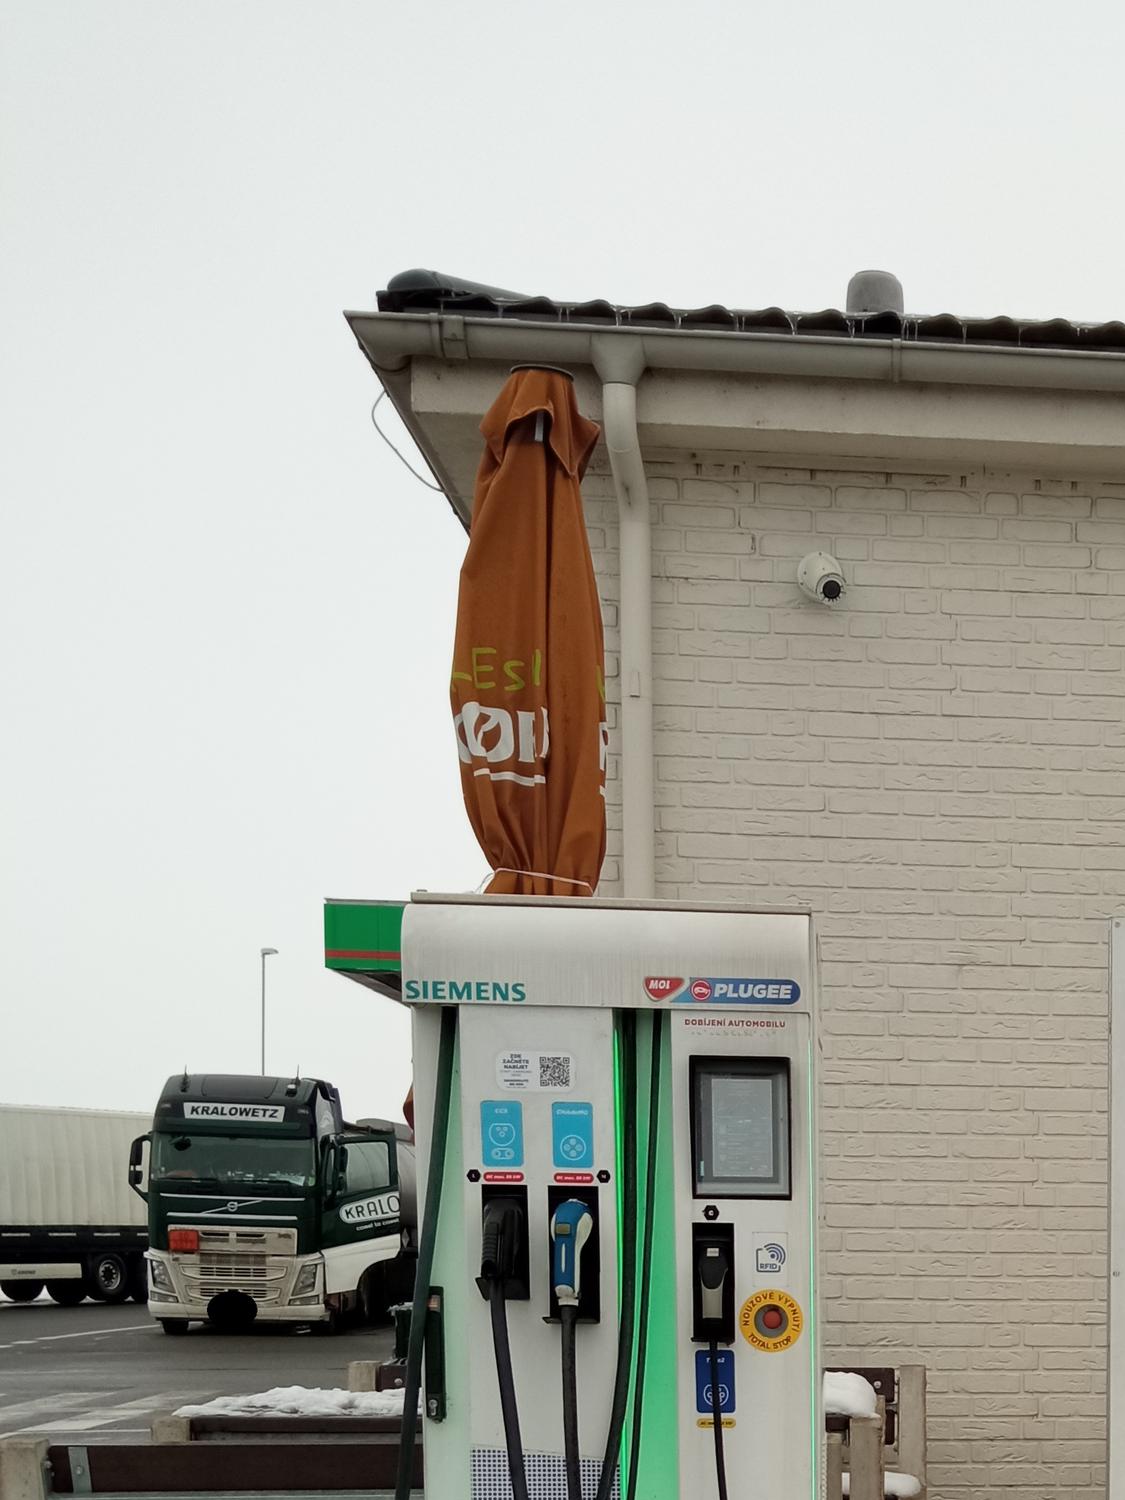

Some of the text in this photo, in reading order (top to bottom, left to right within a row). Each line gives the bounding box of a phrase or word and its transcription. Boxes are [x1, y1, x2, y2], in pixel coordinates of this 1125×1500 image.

[405, 980, 526, 1001] SIEMENS
[649, 980, 792, 998] MOL PLUGEE
[685, 1018, 726, 1026] DOBÍJENÍ
[190, 1105, 279, 1118] KRALOWETZ
[345, 1195, 400, 1219] KRALO
[743, 1292, 800, 1333] NOUZOVÉ VYPNUTÍ
[748, 1333, 793, 1350] TOTAL STOP
